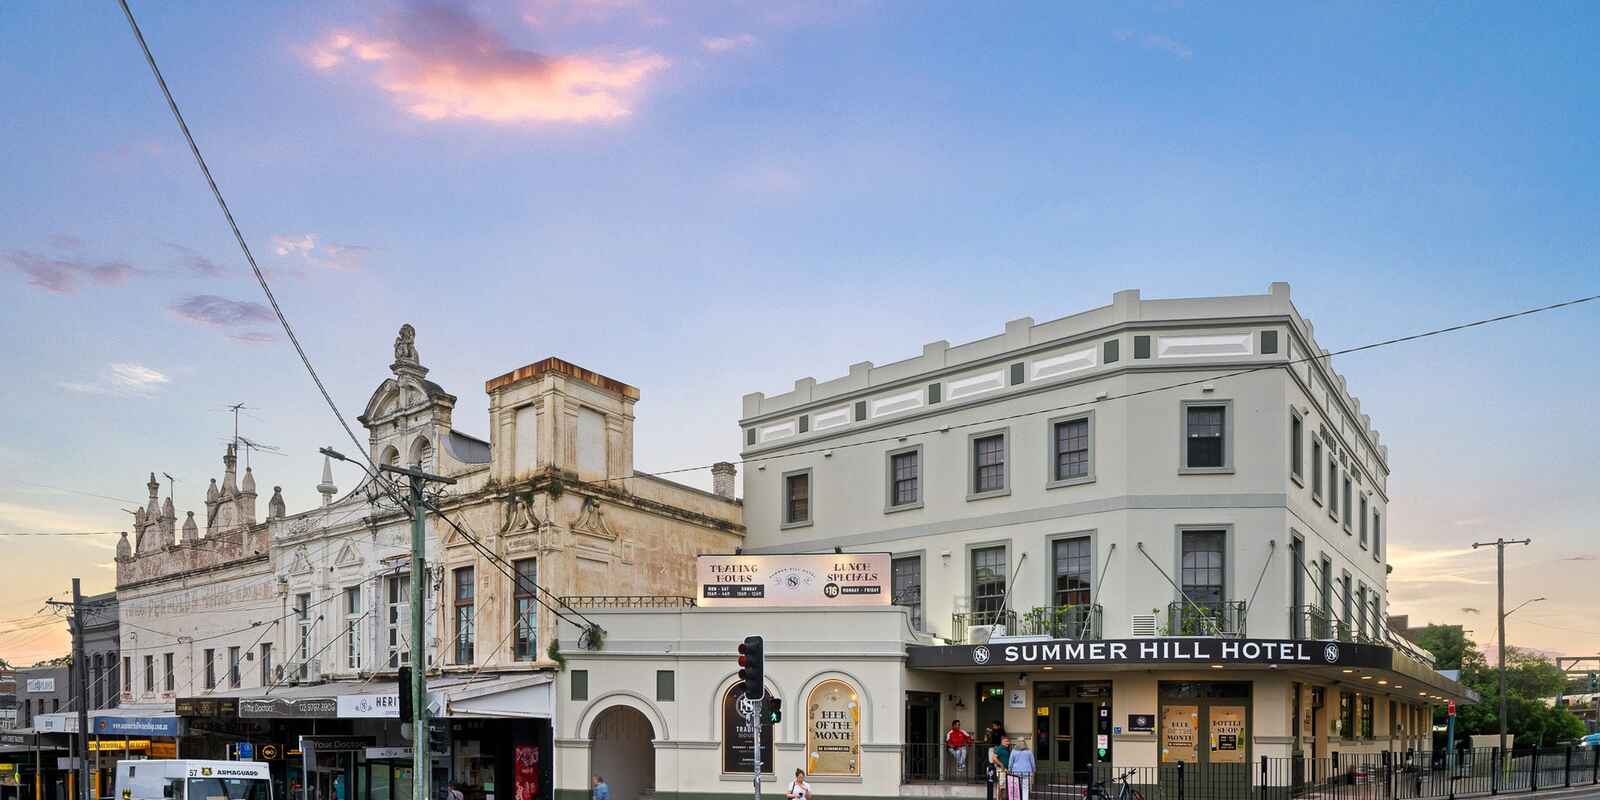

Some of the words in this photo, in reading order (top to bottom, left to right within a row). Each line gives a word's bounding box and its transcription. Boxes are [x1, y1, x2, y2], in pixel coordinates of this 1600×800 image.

[710, 564, 758, 573] TRADING
[834, 563, 871, 572] LUNCH
[716, 574, 753, 583] HOURS
[827, 573, 878, 582] SPECIALS
[1005, 643, 1128, 662] SUMMER
[1140, 642, 1210, 660] HILL
[1222, 642, 1311, 660] HOTEL
[822, 711, 847, 719] BEER
[815, 721, 830, 730] OF
[831, 721, 853, 730] THE
[815, 731, 854, 740] MONTH
[190, 769, 198, 777] 57
